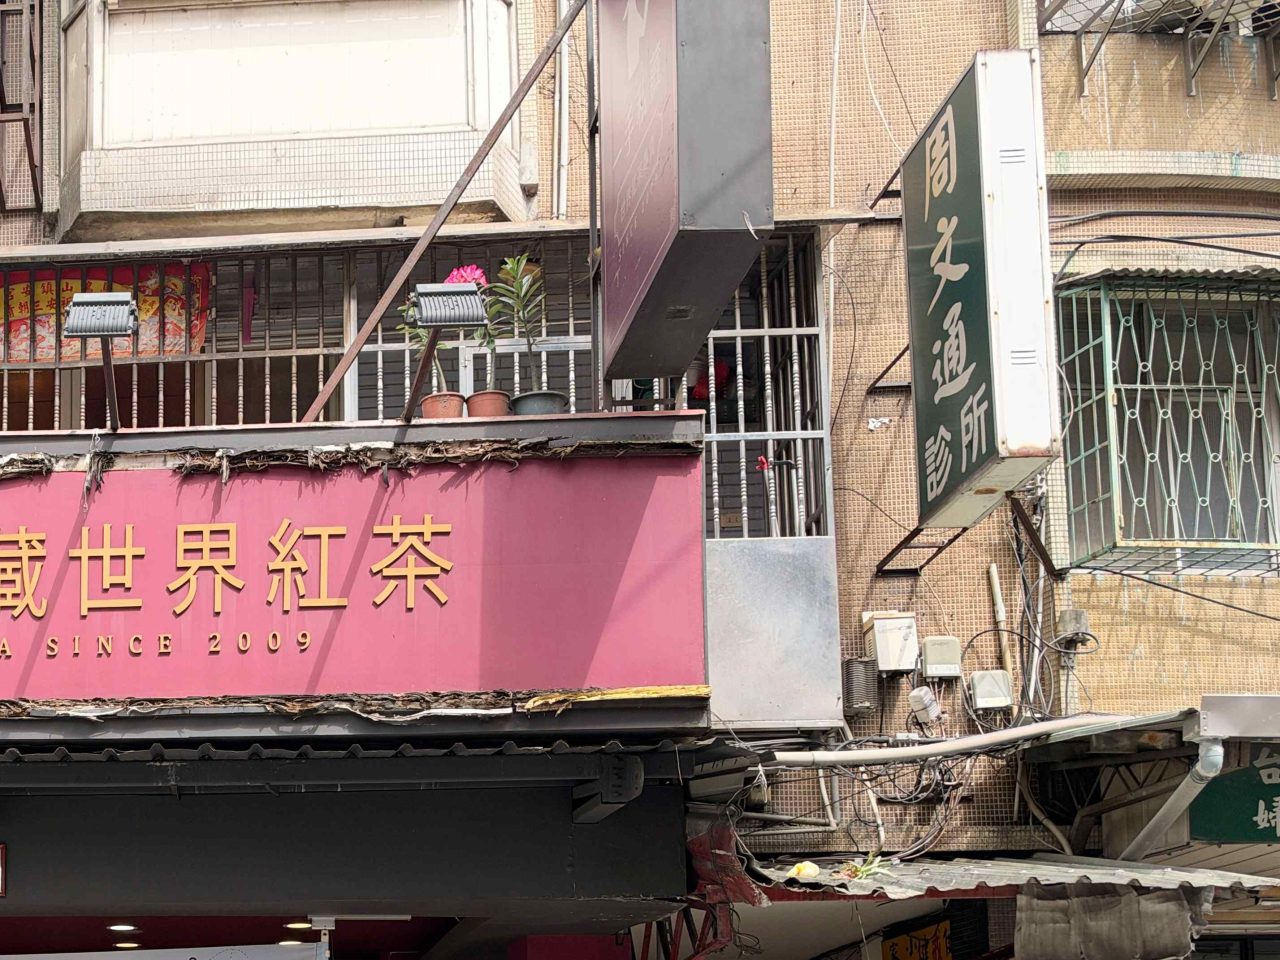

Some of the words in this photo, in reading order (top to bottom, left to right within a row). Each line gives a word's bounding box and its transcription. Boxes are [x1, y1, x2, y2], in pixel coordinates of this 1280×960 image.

[923, 104, 978, 404] 周文通
[923, 383, 990, 503] 診所
[46, 634, 174, 657] SINCE
[208, 631, 315, 654] 2009
